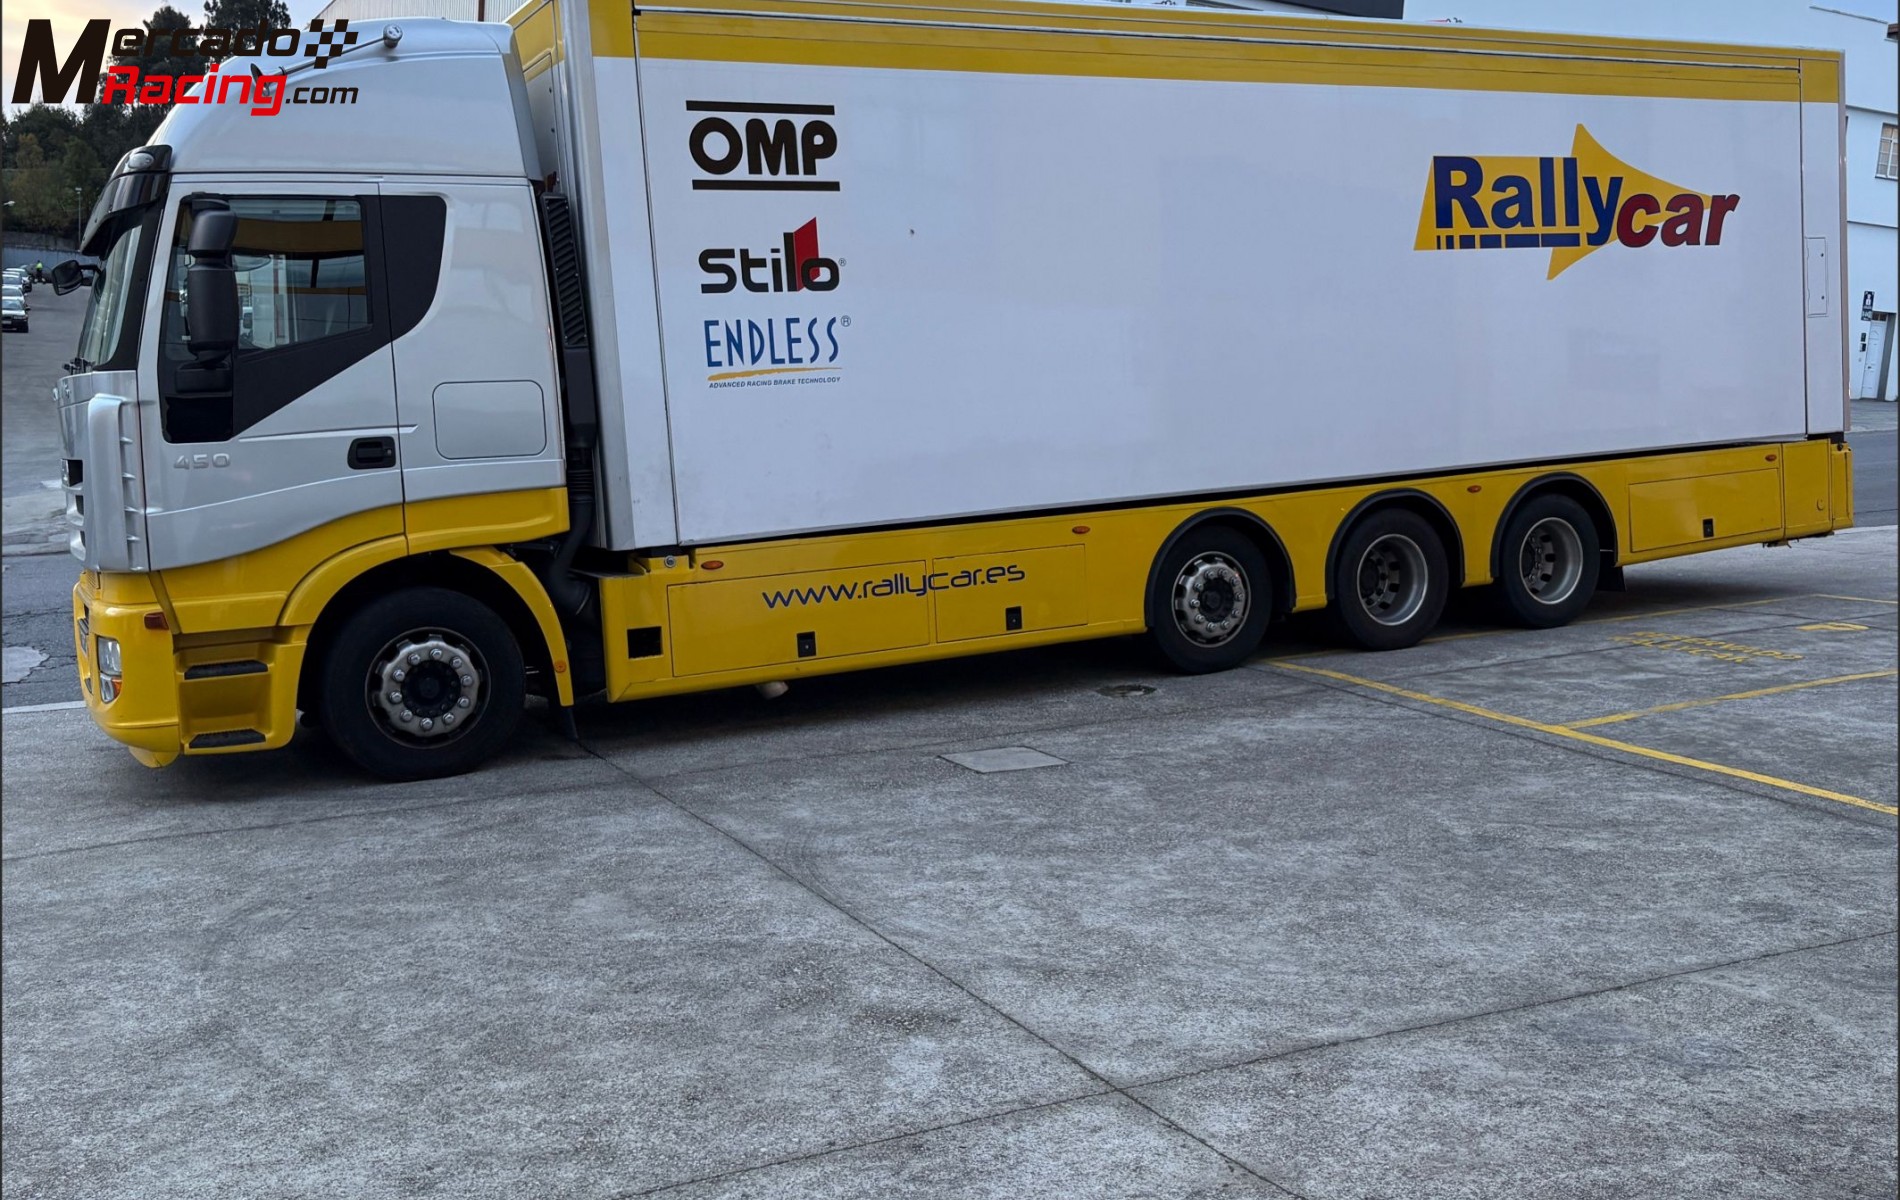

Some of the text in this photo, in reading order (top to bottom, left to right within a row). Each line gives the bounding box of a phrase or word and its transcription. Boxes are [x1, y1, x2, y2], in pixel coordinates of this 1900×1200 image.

[689, 117, 837, 176] OMP
[1433, 155, 1741, 248] Rallycar
[698, 232, 840, 294] Stilo
[704, 316, 839, 367] ENDLESS
[709, 376, 841, 389] ADVANCED RACING BRAKE TECHNOLOGY
[173, 453, 231, 470] 450
[762, 565, 1025, 609] www.rallycar.es
